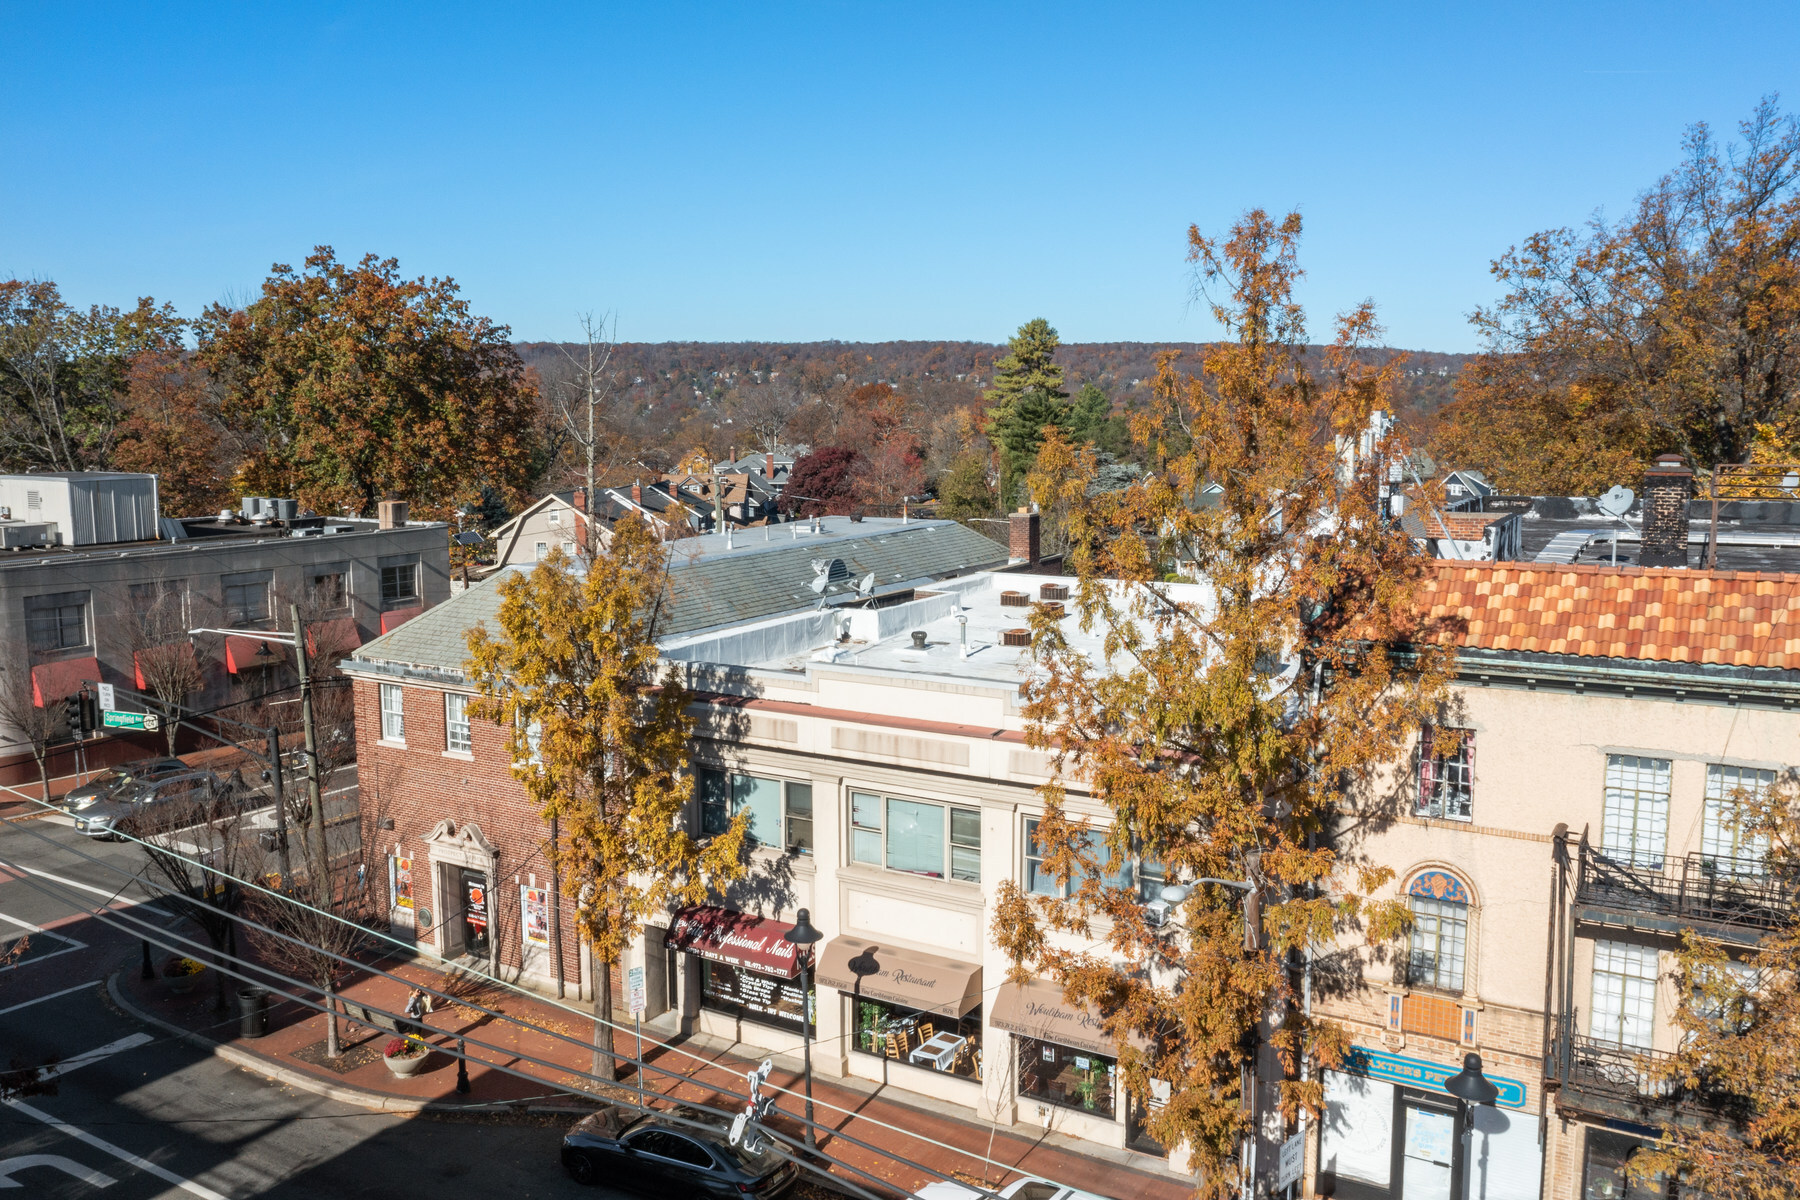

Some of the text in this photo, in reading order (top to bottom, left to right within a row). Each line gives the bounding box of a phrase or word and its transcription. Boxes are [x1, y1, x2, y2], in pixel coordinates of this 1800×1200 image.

[106, 713, 135, 725] Springfield
[709, 924, 768, 951] Professional
[766, 939, 795, 959] Nails
[705, 951, 718, 960] DAYS
[725, 956, 740, 965] WEEK
[892, 968, 936, 988] Restaurant
[749, 1003, 763, 1012] WALK
[779, 1010, 804, 1022] WELCOME
[1356, 1056, 1421, 1079] BAXTER'S
